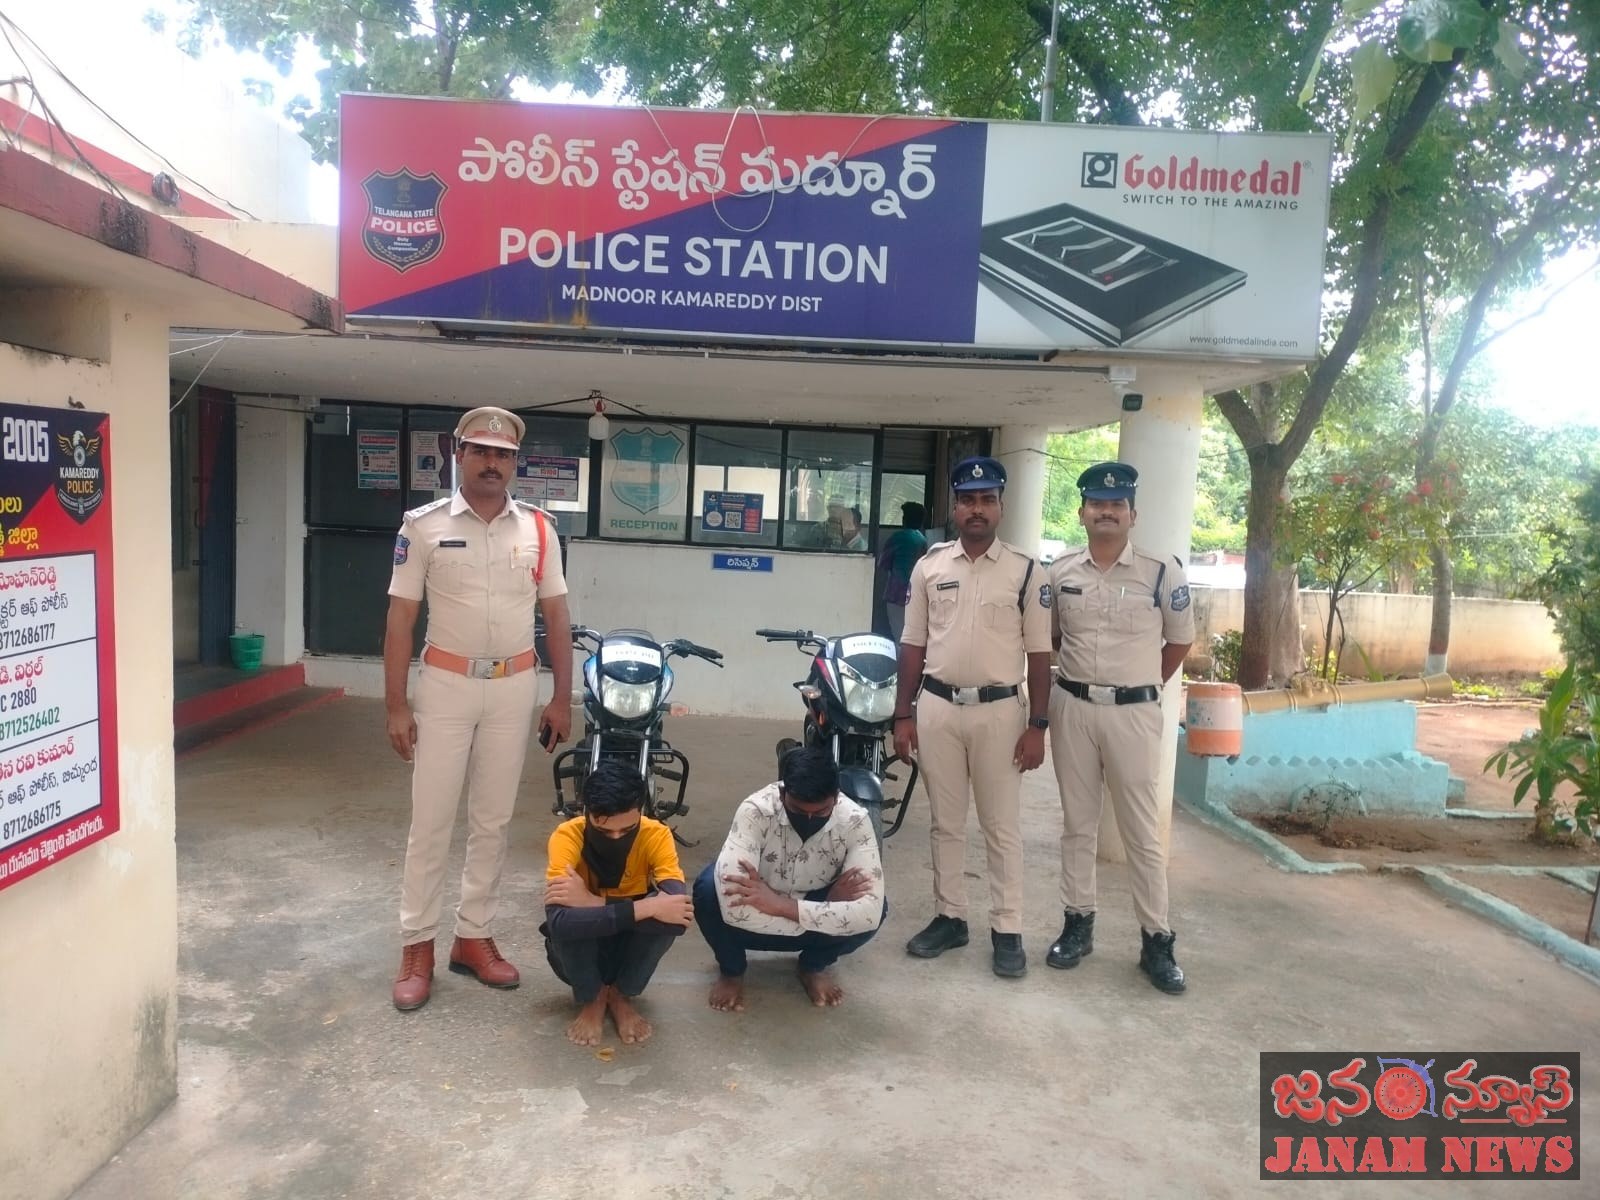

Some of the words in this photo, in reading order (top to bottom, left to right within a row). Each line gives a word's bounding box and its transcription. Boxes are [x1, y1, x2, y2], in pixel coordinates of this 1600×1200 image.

[458, 133, 600, 188] పోలీస్
[611, 139, 726, 212] స్టేషన్
[1124, 154, 1302, 196] Goldmedal
[374, 206, 412, 218] TELANGANA
[413, 208, 434, 218] STATE
[1123, 193, 1174, 205] SWITCH
[1181, 196, 1197, 206] TO
[1205, 197, 1228, 207] THE
[1234, 199, 1299, 210] AMAZING
[371, 216, 438, 234] POLICE
[500, 227, 670, 274] POLICE
[684, 236, 888, 285] STATION
[562, 284, 656, 305] MADNOOR
[661, 289, 777, 311] KAMAREDDY
[781, 296, 822, 312] DIST
[1189, 336, 1298, 348] www.goldmedalindia.com
[3, 417, 49, 463] 2005
[60, 466, 99, 479] KAMAREDDY
[67, 480, 94, 494] POLICE
[610, 519, 678, 531] RECEPTION
[10, 686, 37, 710] 2880
[3, 799, 61, 841] 8712686175
